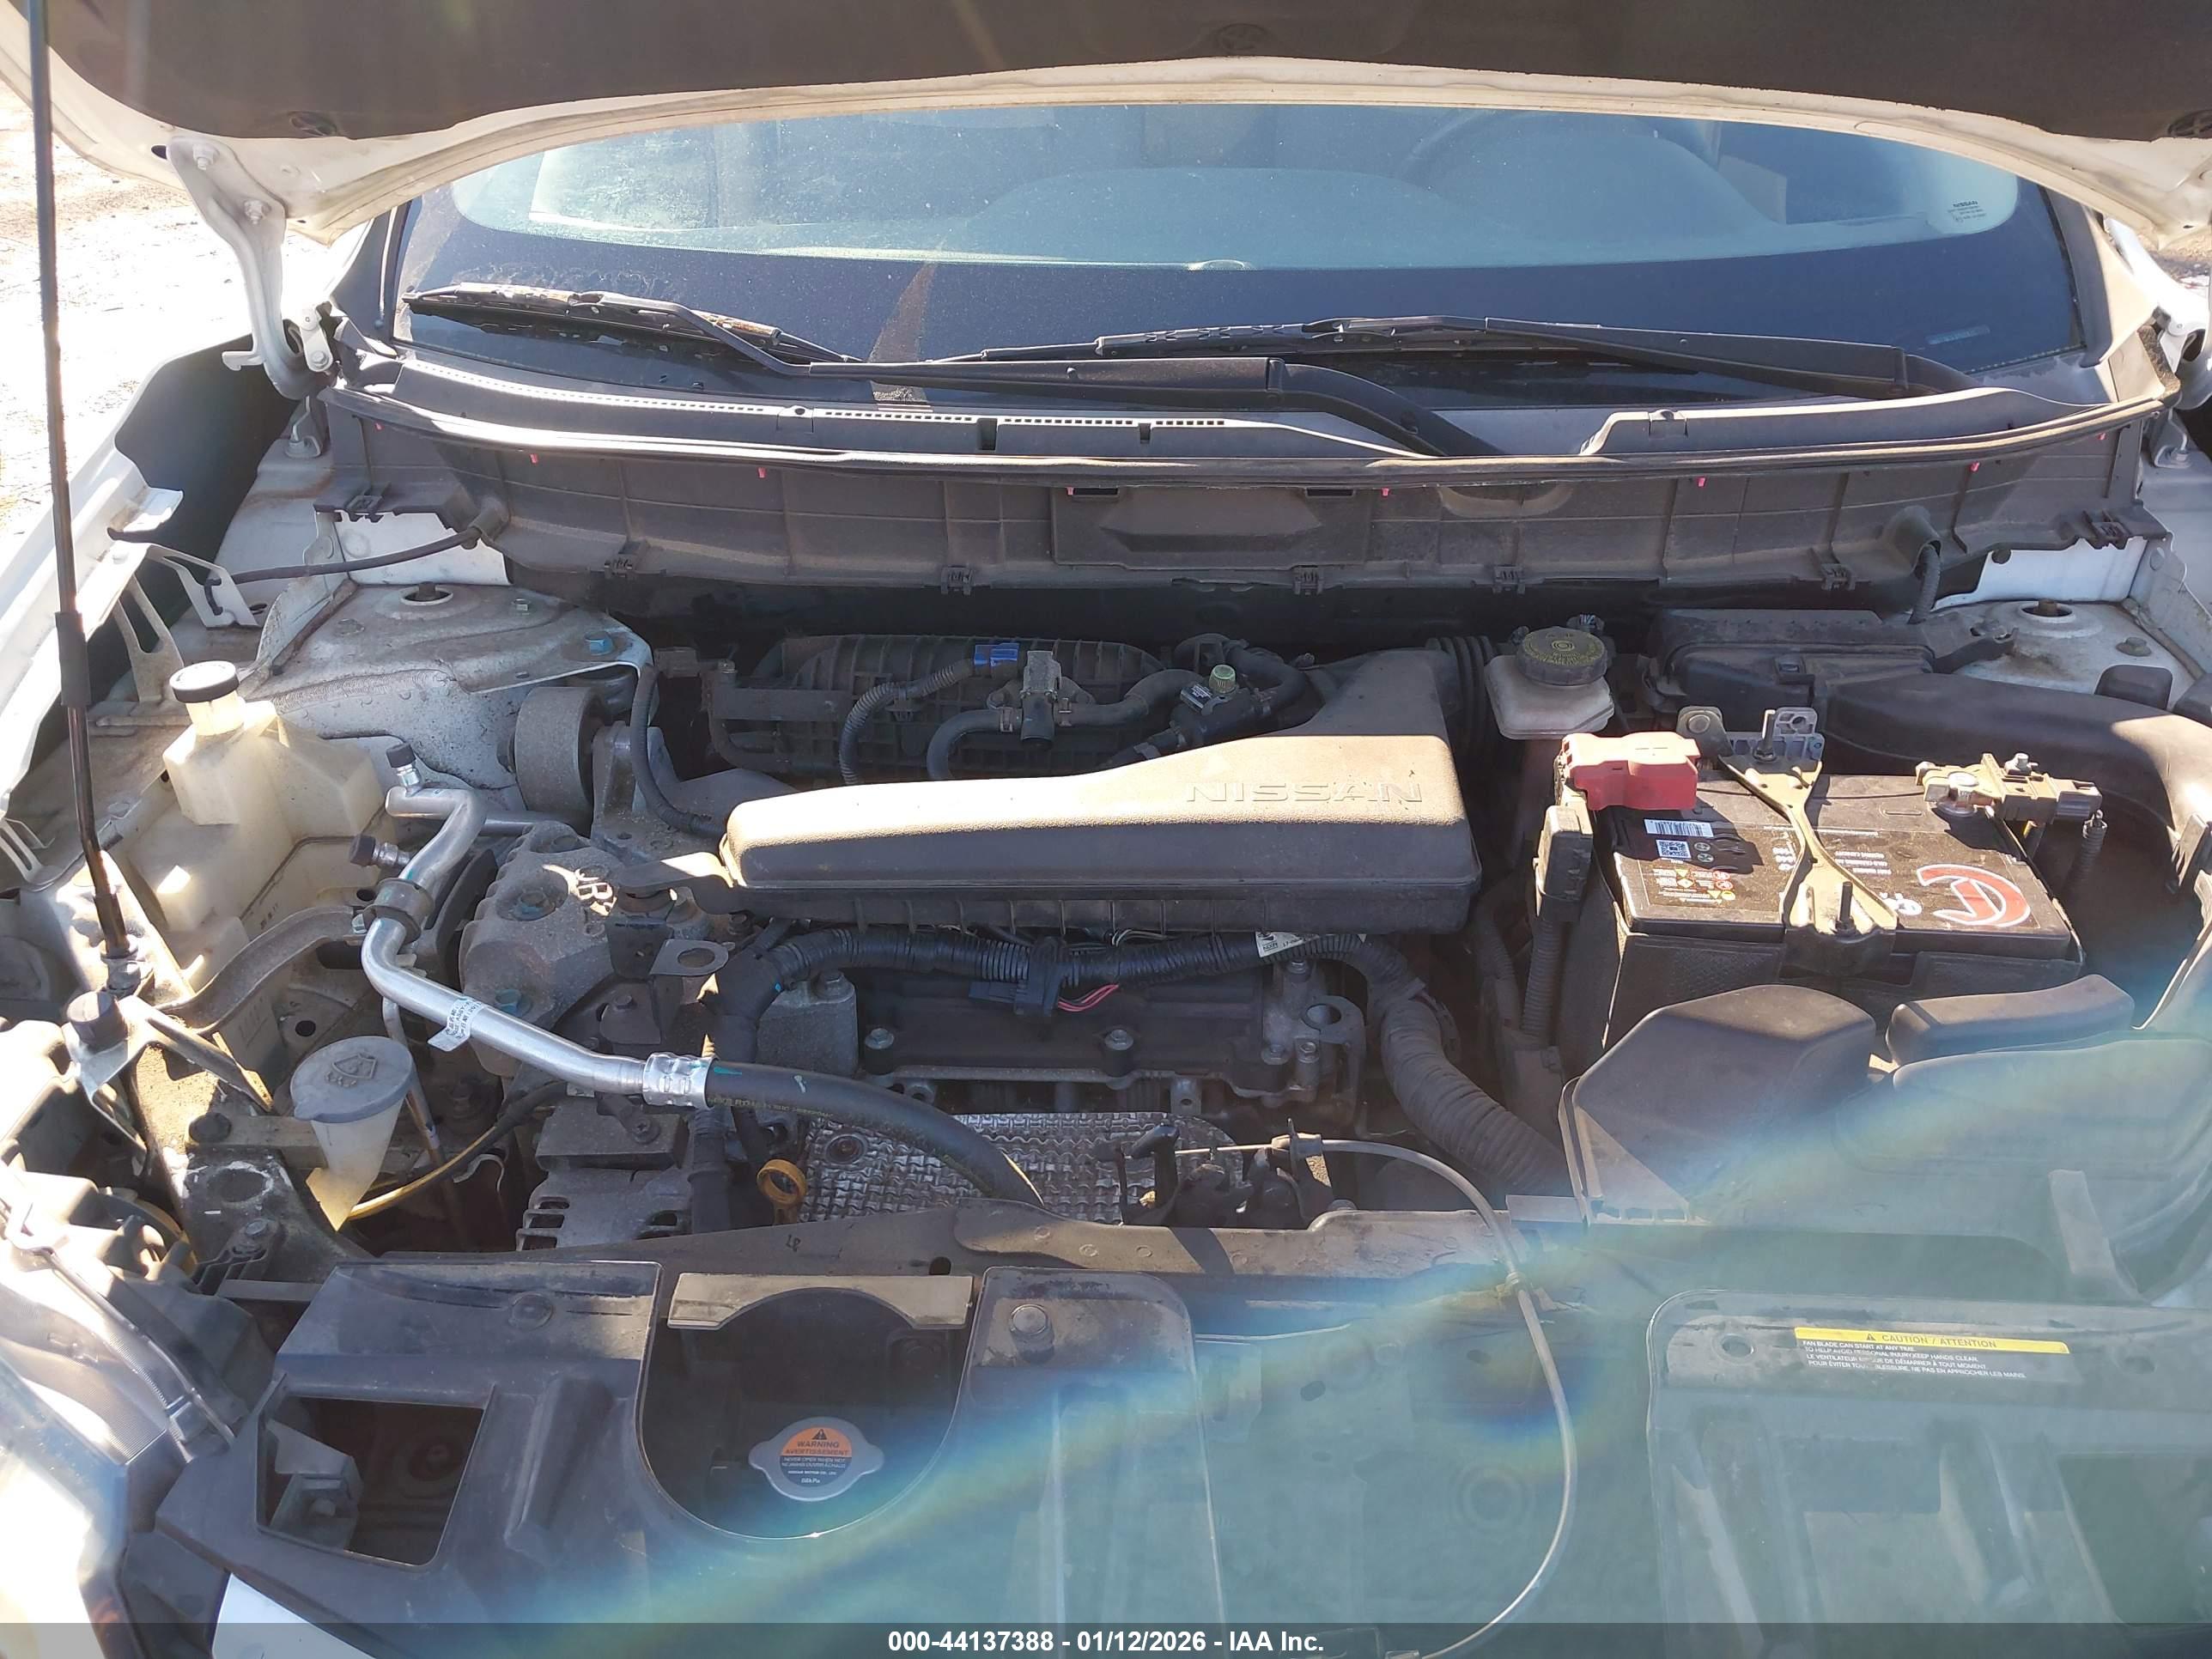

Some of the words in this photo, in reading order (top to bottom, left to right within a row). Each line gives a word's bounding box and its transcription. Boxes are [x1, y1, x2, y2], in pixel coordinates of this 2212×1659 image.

[1187, 782, 1422, 802] NISSAN
[1882, 1334, 1929, 1344] CAUTION
[1941, 1339, 1996, 1347] ATTENTION
